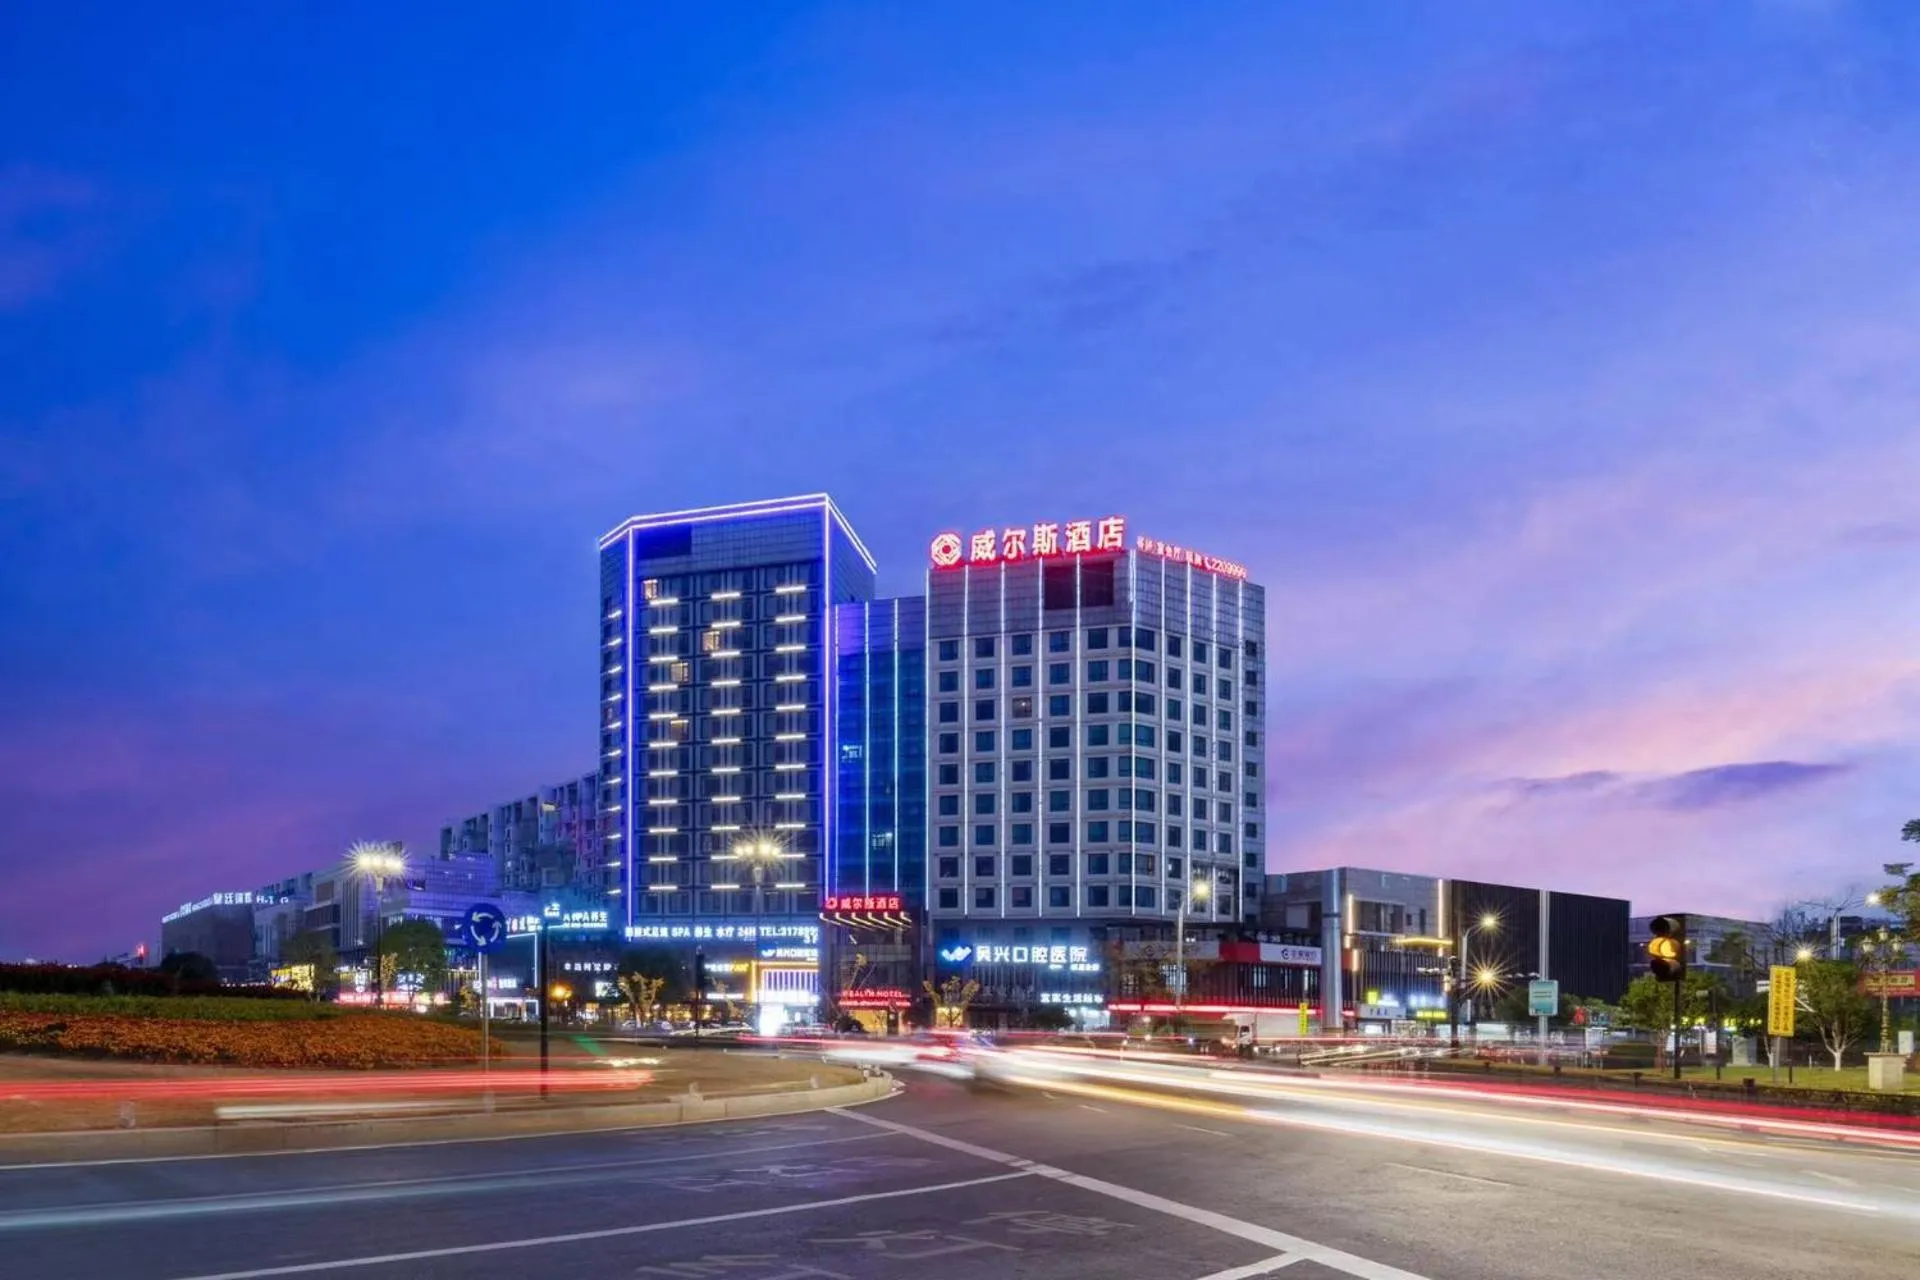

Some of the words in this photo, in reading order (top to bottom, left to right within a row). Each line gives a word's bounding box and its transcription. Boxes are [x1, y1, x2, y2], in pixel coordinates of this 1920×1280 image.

[971, 516, 1124, 562] 威尔斯酒店
[841, 897, 899, 909] 威尔斯酒店
[671, 927, 690, 937] SPA
[975, 944, 1087, 963] 吴兴口腔医院
